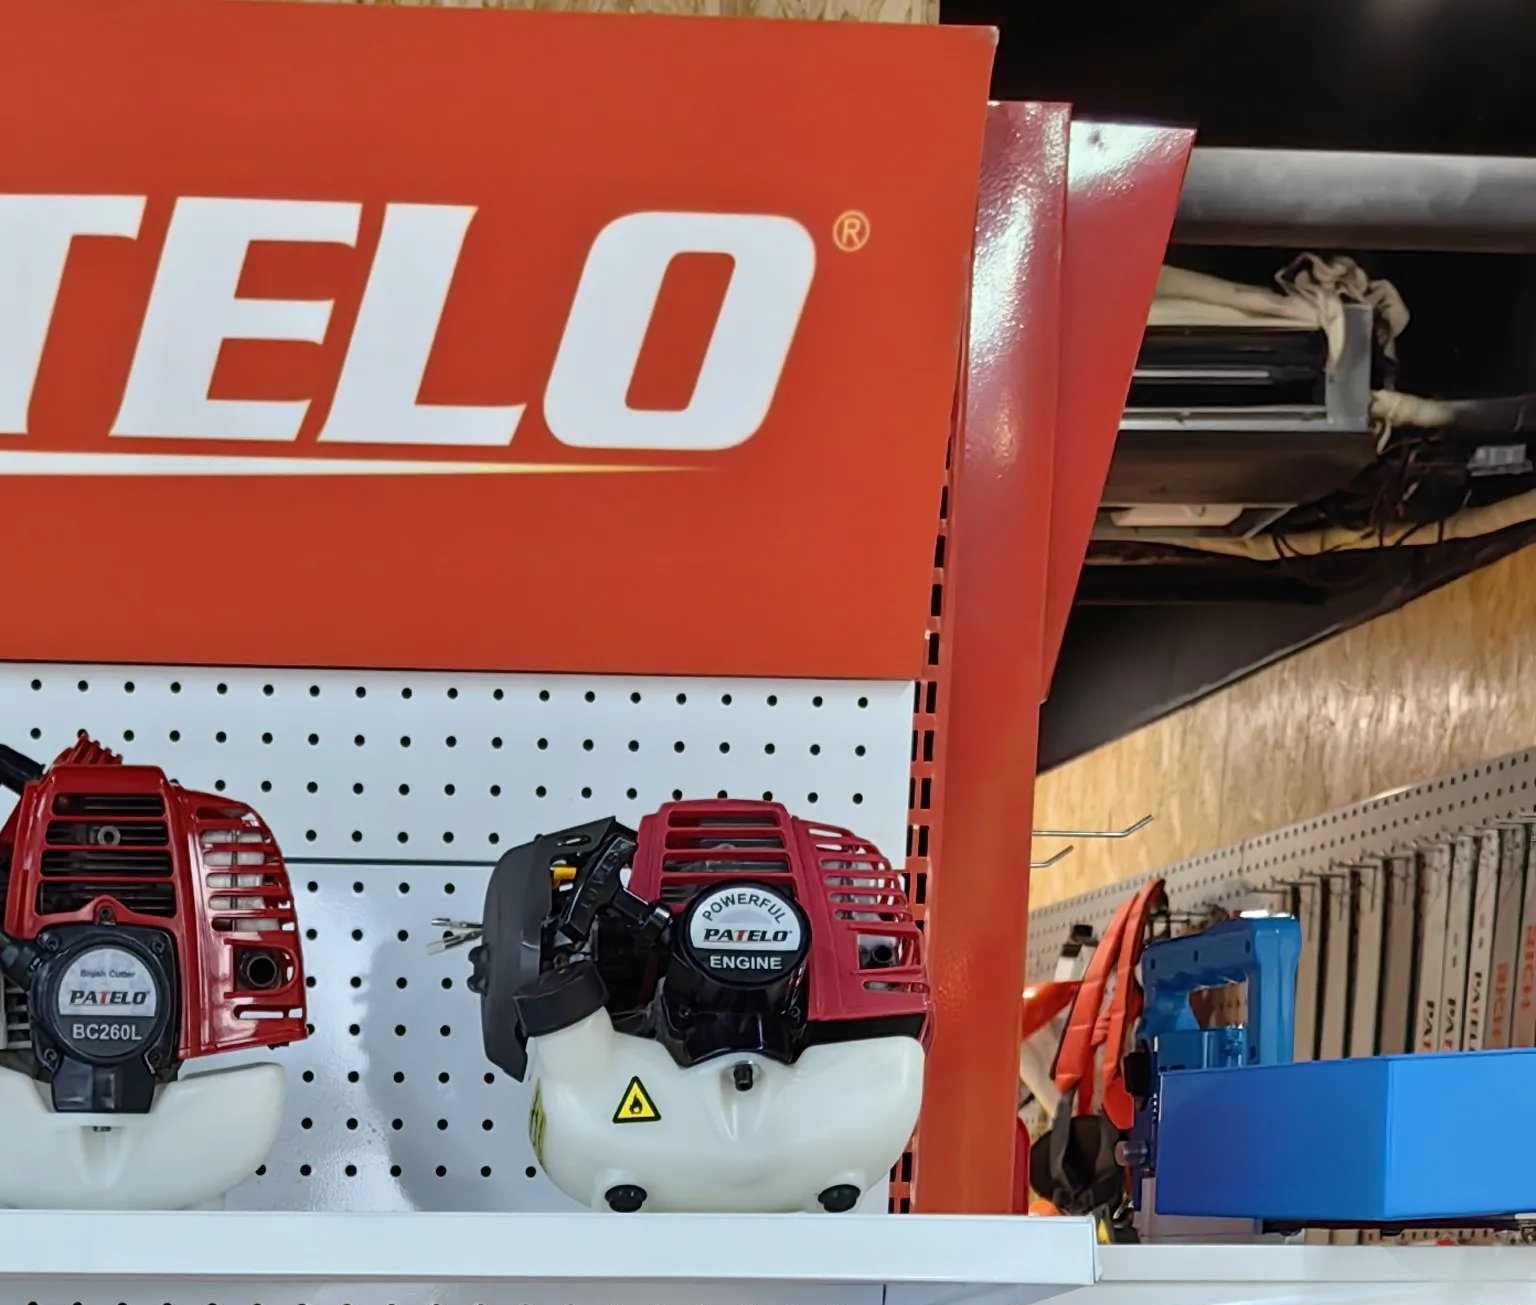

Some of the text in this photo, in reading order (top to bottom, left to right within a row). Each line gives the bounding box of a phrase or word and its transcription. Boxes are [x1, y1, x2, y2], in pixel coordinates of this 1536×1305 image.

[702, 893, 786, 924] POWERFUL
[703, 928, 789, 943] PATELO
[709, 955, 783, 970] ENGINE
[109, 969, 136, 979] Cutter
[69, 989, 148, 1005] PATELO
[72, 1023, 143, 1040] BC260L
